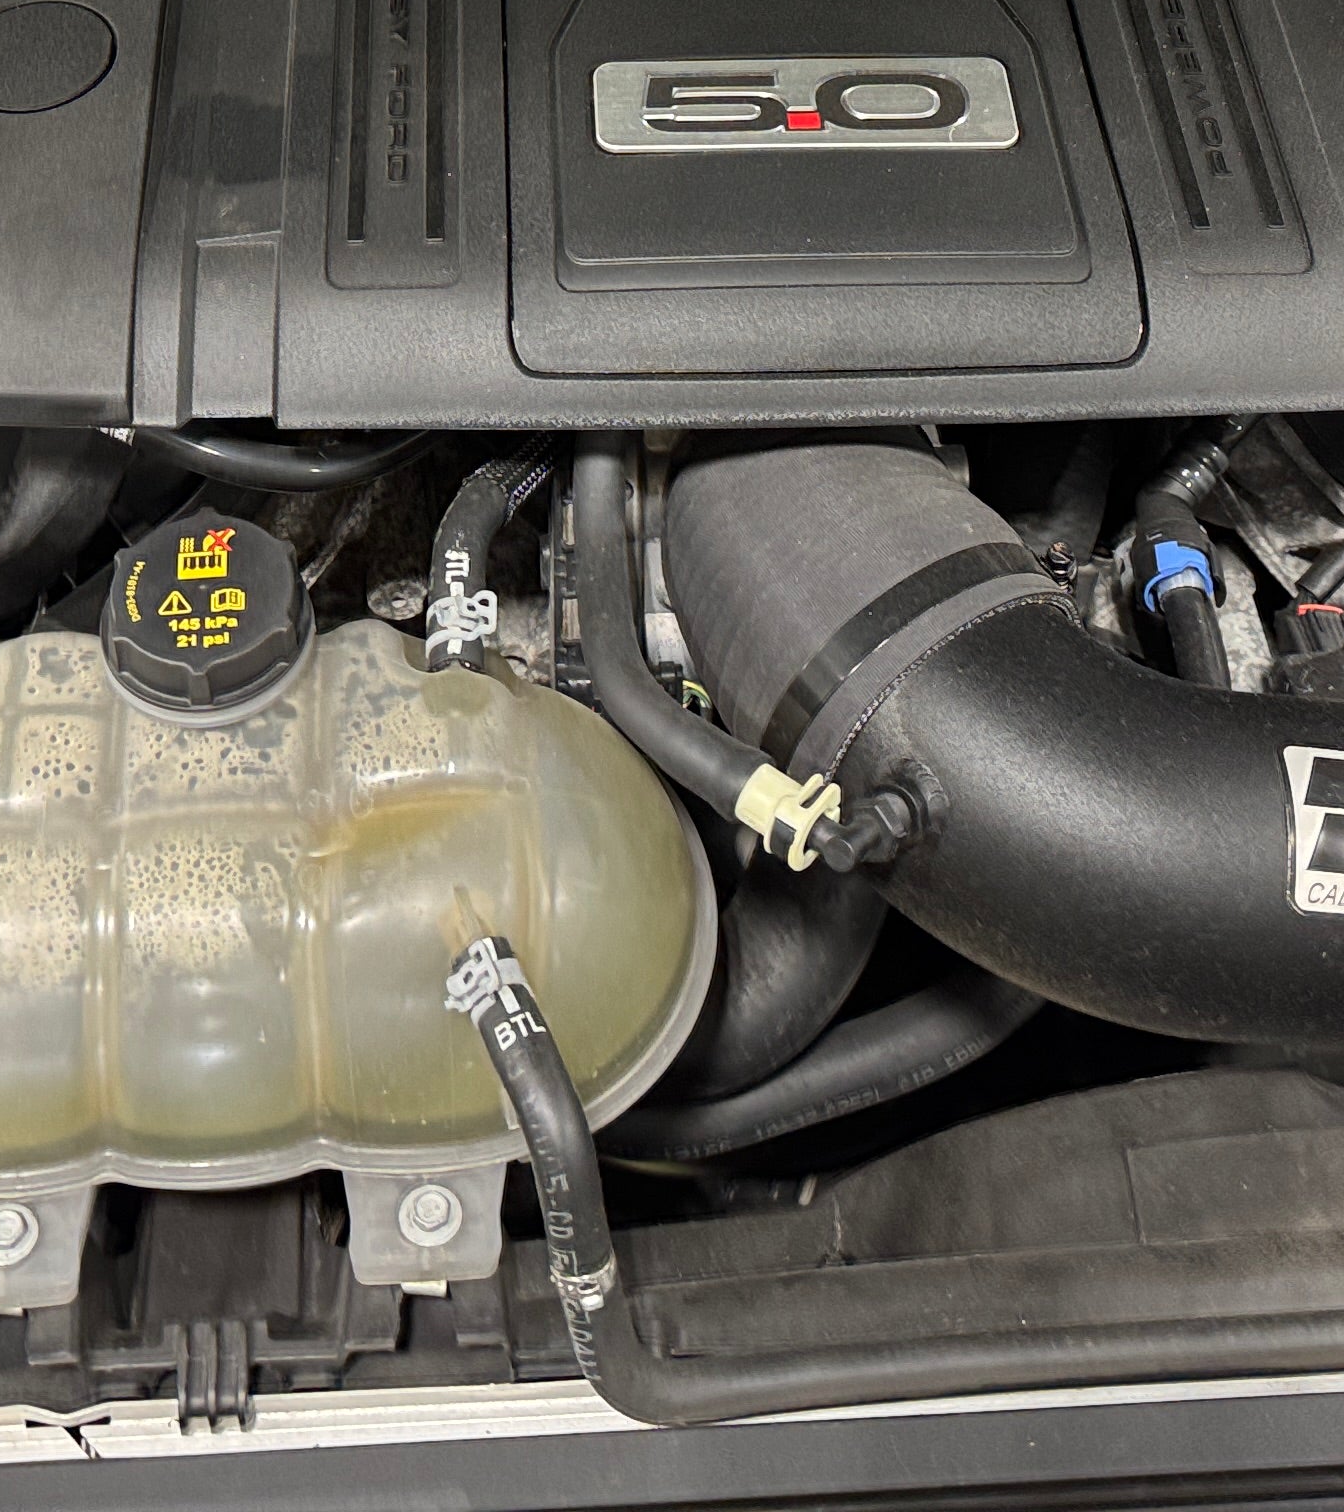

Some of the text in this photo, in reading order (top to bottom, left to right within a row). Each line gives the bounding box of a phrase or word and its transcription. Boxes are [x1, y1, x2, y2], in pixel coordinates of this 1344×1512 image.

[642, 69, 969, 133] 5.0
[384, 63, 409, 185] FORD
[168, 616, 239, 632] 145 kPa
[176, 631, 230, 648] 21 psi
[494, 1011, 547, 1051] BTL
